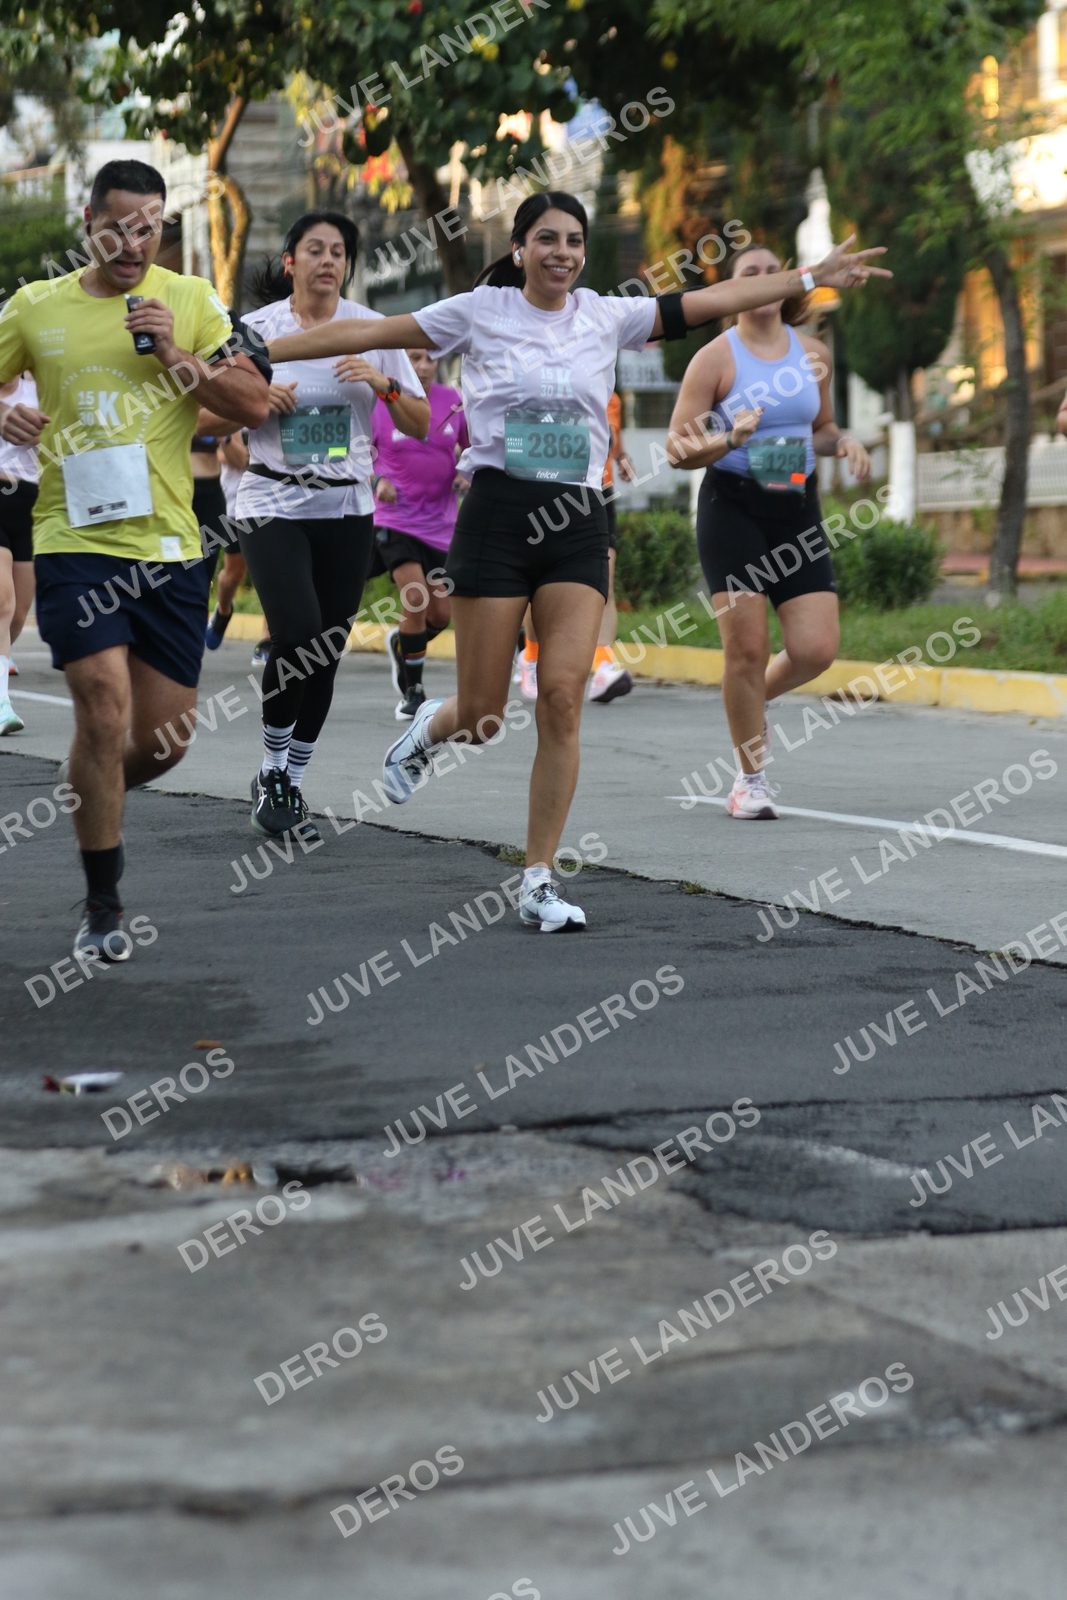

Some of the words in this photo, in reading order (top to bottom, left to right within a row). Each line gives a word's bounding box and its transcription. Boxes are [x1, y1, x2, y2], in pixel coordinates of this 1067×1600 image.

[78, 390, 95, 406] 15
[97, 390, 122, 426] K
[298, 422, 348, 445] 3689
[527, 431, 587, 460] 2862
[536, 470, 560, 480] telcel
